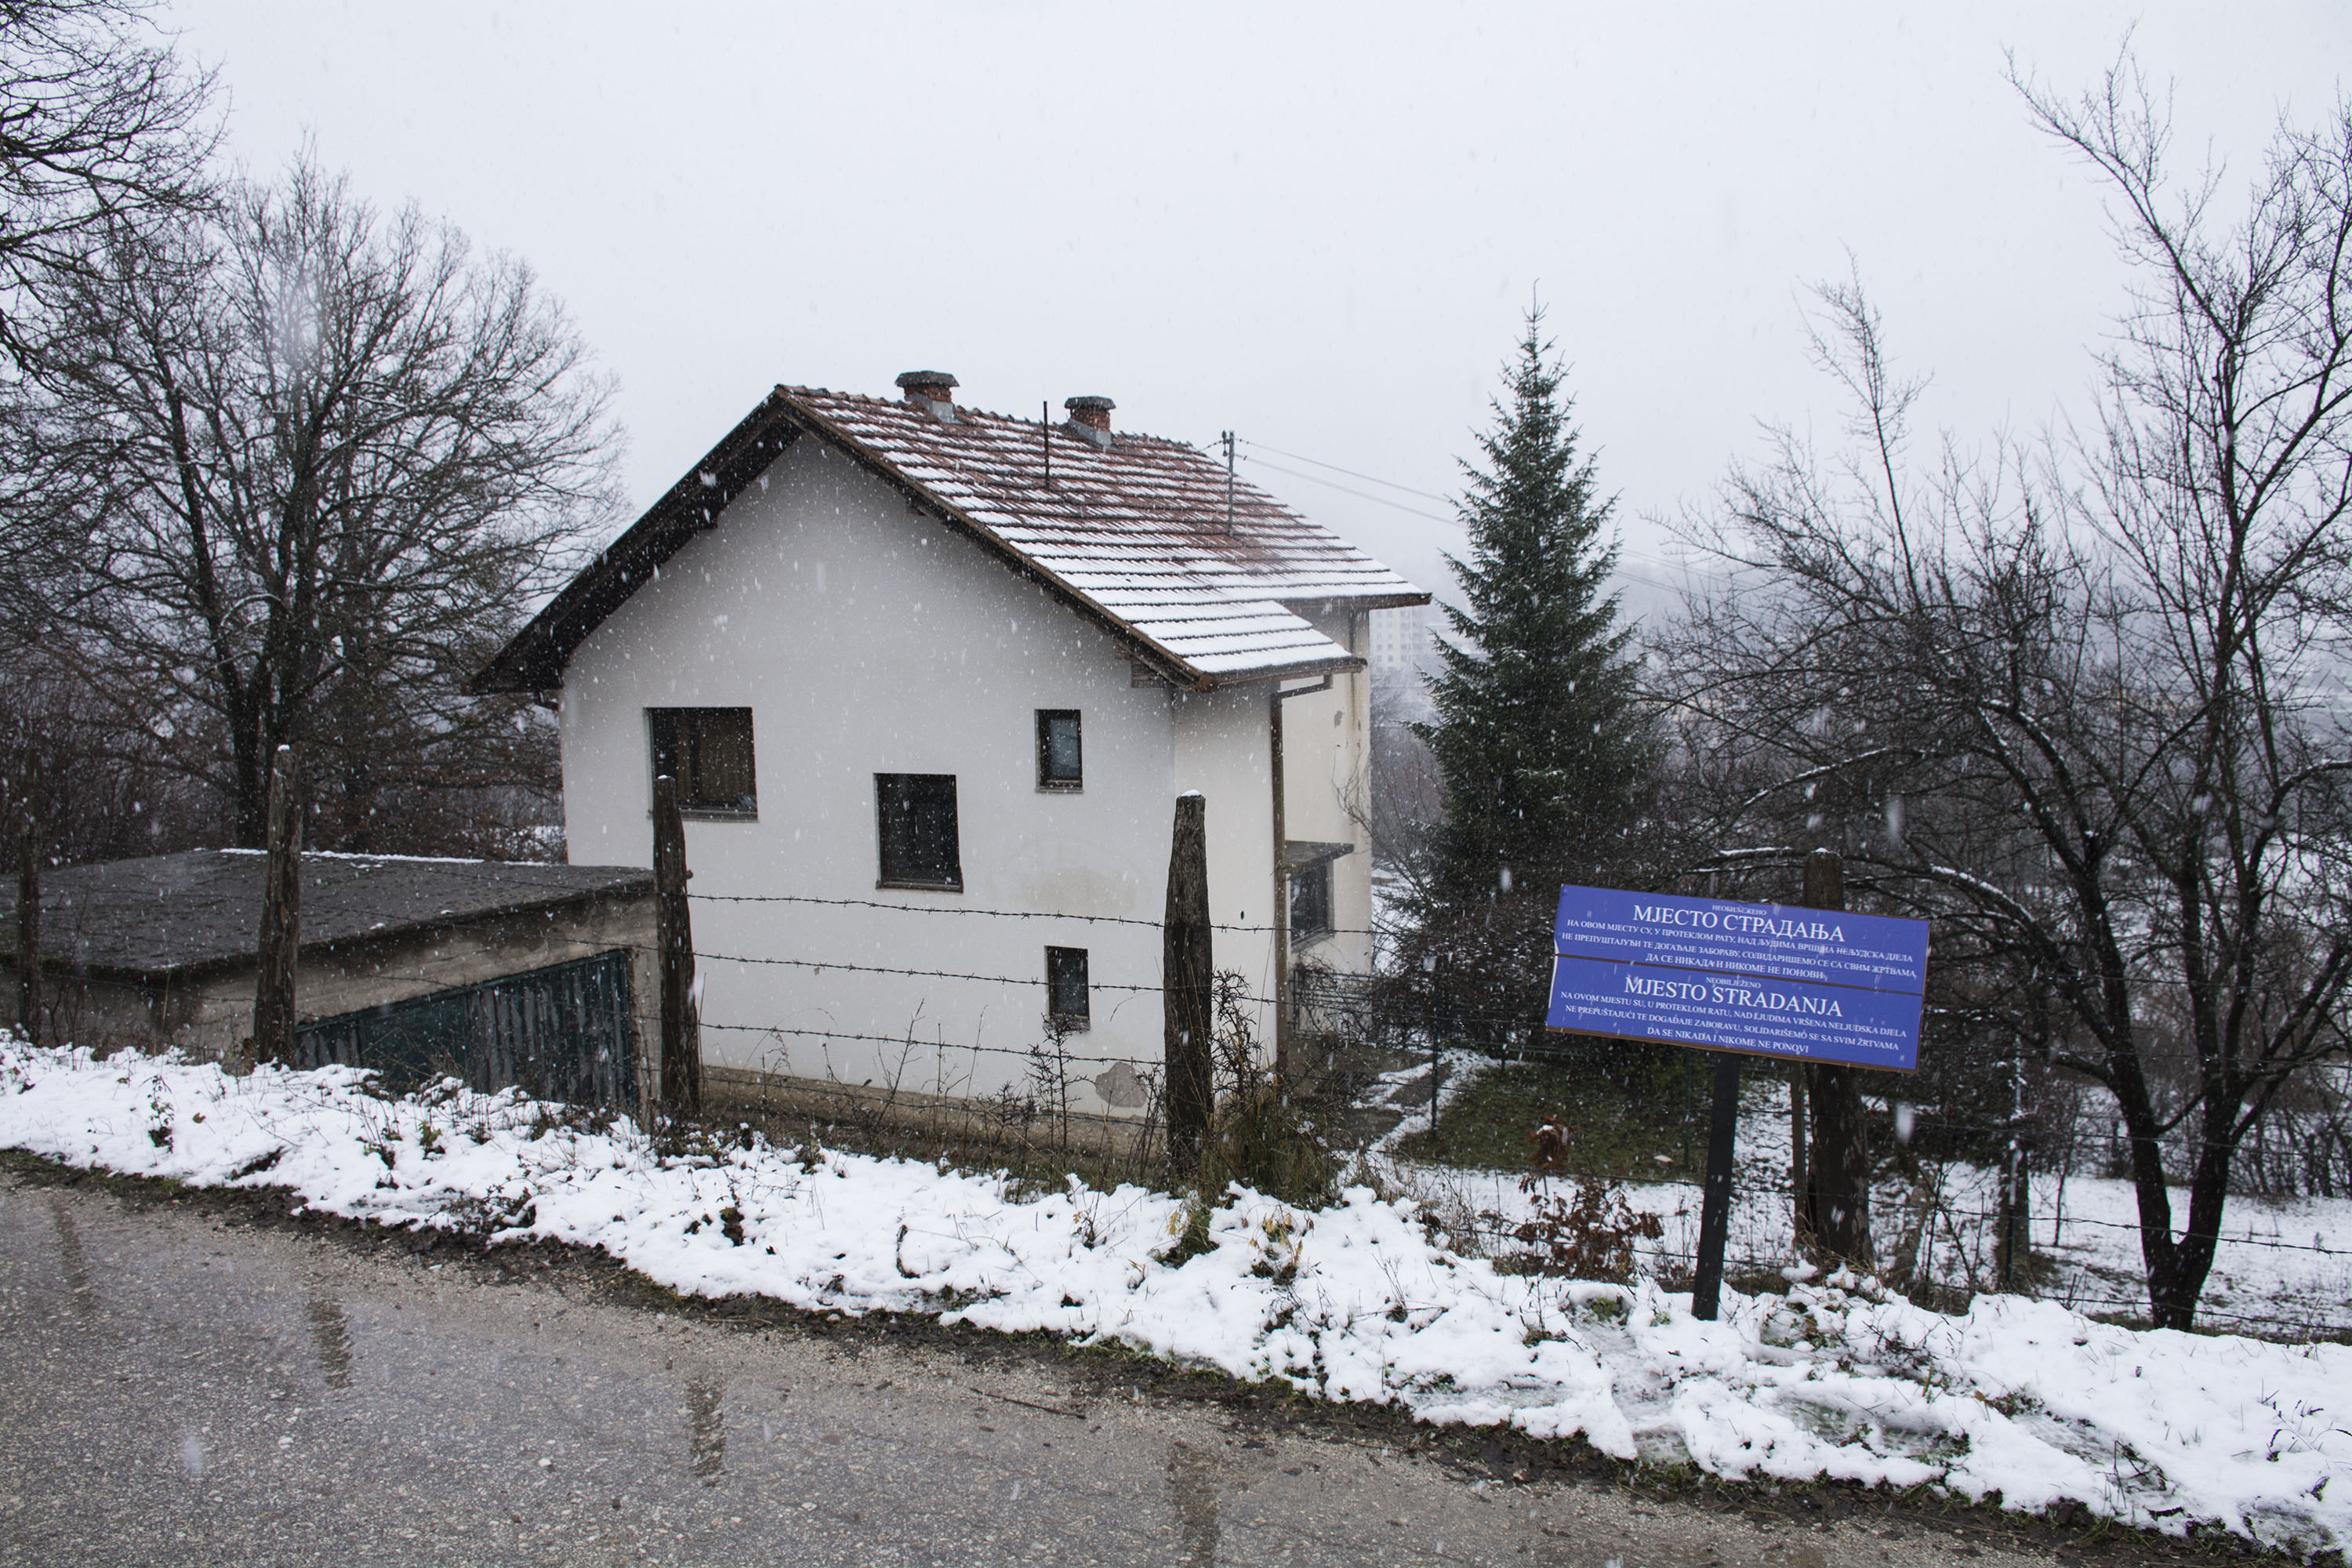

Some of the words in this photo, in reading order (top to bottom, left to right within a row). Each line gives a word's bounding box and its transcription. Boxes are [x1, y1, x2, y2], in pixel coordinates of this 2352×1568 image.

[1567, 919, 1580, 927] НА
[1581, 920, 1605, 930] ОВОМ
[1607, 924, 1639, 933] МЈЕСТУ
[1662, 929, 1713, 941] ПРОТЕКЛОМ
[1738, 937, 1756, 946] НАД
[1758, 939, 1795, 949] ЉУДИМА
[1836, 947, 1884, 959] НЕЉУДСКА
[1886, 953, 1913, 962] ДЈЕЛА
[1633, 905, 1718, 928] МЈЕСТО
[1723, 914, 1845, 942] СТРАДАЊА
[1574, 934, 1641, 947] ПРЕПУШТАЈУЋИ
[1654, 942, 1697, 953] ДОГАЂАЈЕ
[1742, 951, 1816, 966] СОЛИДАРИШЕМО
[1844, 962, 1870, 971] СВИМ
[1675, 956, 1714, 967] НИКАДА
[1726, 961, 1766, 972] НИКОМЕ
[1768, 966, 1780, 975] НЕ
[1624, 977, 1707, 1000] MJESTO
[1712, 986, 1842, 1017] STRADANJA
[1706, 977, 1761, 988] NEOBILJEŽENO
[1573, 993, 1599, 1002] OVOM
[1601, 996, 1632, 1005] MJESTU
[1656, 1002, 1706, 1014] PROTEKLOM
[1733, 1011, 1752, 1019] NAD
[1754, 1012, 1791, 1024] LJUDIMA
[1793, 1017, 1827, 1029] VRŠENA
[1828, 1022, 1878, 1034] NELJUDSKA
[1880, 1028, 1907, 1037] DJELA
[1577, 1006, 1635, 1019] PREPUŠTAJUĆI
[1649, 1014, 1693, 1026] DOGAĐAJE
[1744, 1025, 1807, 1039] SOLIDARIŠEMO
[1809, 1033, 1820, 1041] SE
[1821, 1034, 1832, 1043] SA
[1834, 1036, 1856, 1045] SVIM
[1857, 1037, 1899, 1051] ŽRTVAMA
[1675, 1030, 1711, 1041] NIKADA
[1719, 1036, 1756, 1047] NIKOME
[1773, 1042, 1809, 1053] PONOVI
